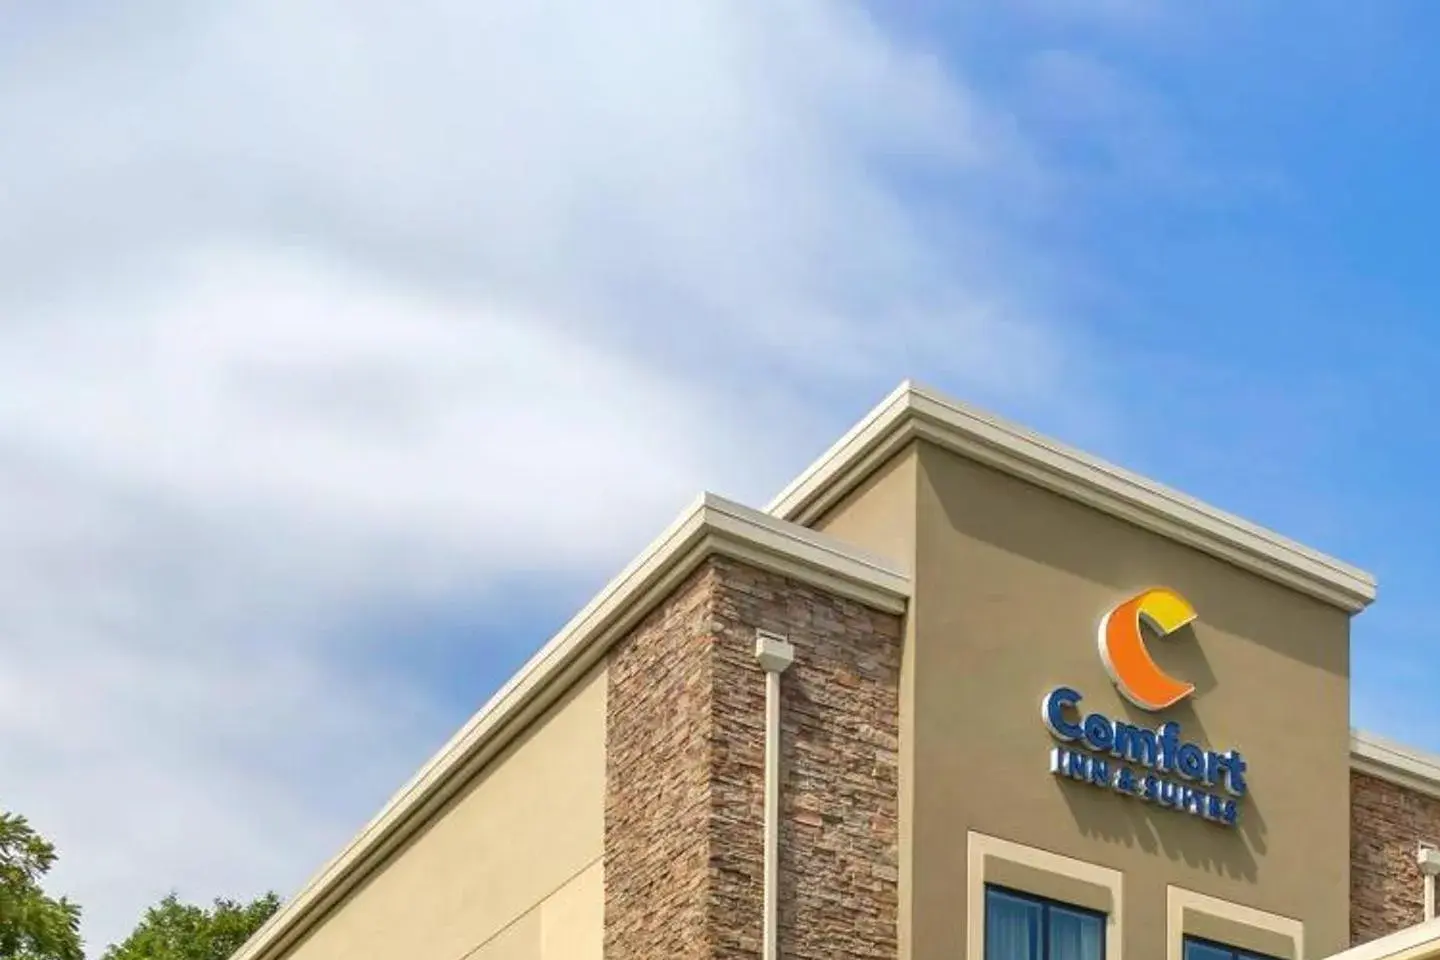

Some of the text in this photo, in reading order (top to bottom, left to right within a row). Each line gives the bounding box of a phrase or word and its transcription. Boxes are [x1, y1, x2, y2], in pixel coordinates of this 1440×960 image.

[1042, 686, 1246, 796] Comfort
[1050, 747, 1237, 825] INN & SUITES
